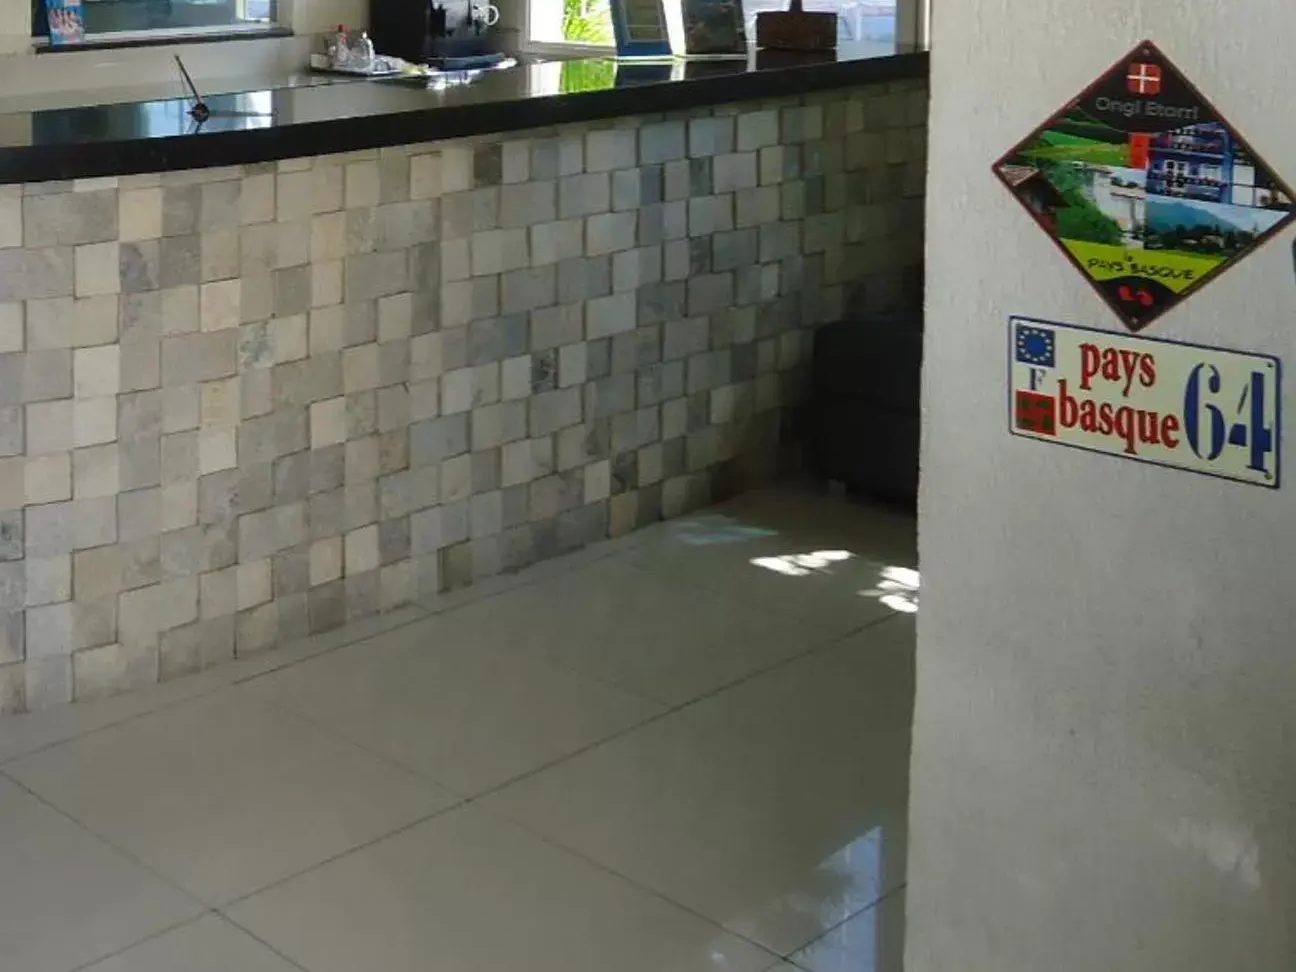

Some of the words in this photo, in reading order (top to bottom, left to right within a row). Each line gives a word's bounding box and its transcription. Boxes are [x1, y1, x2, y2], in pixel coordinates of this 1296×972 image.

[1079, 343, 1157, 398] pays
[1057, 379, 1181, 456] basque
[1183, 362, 1273, 474] 64
